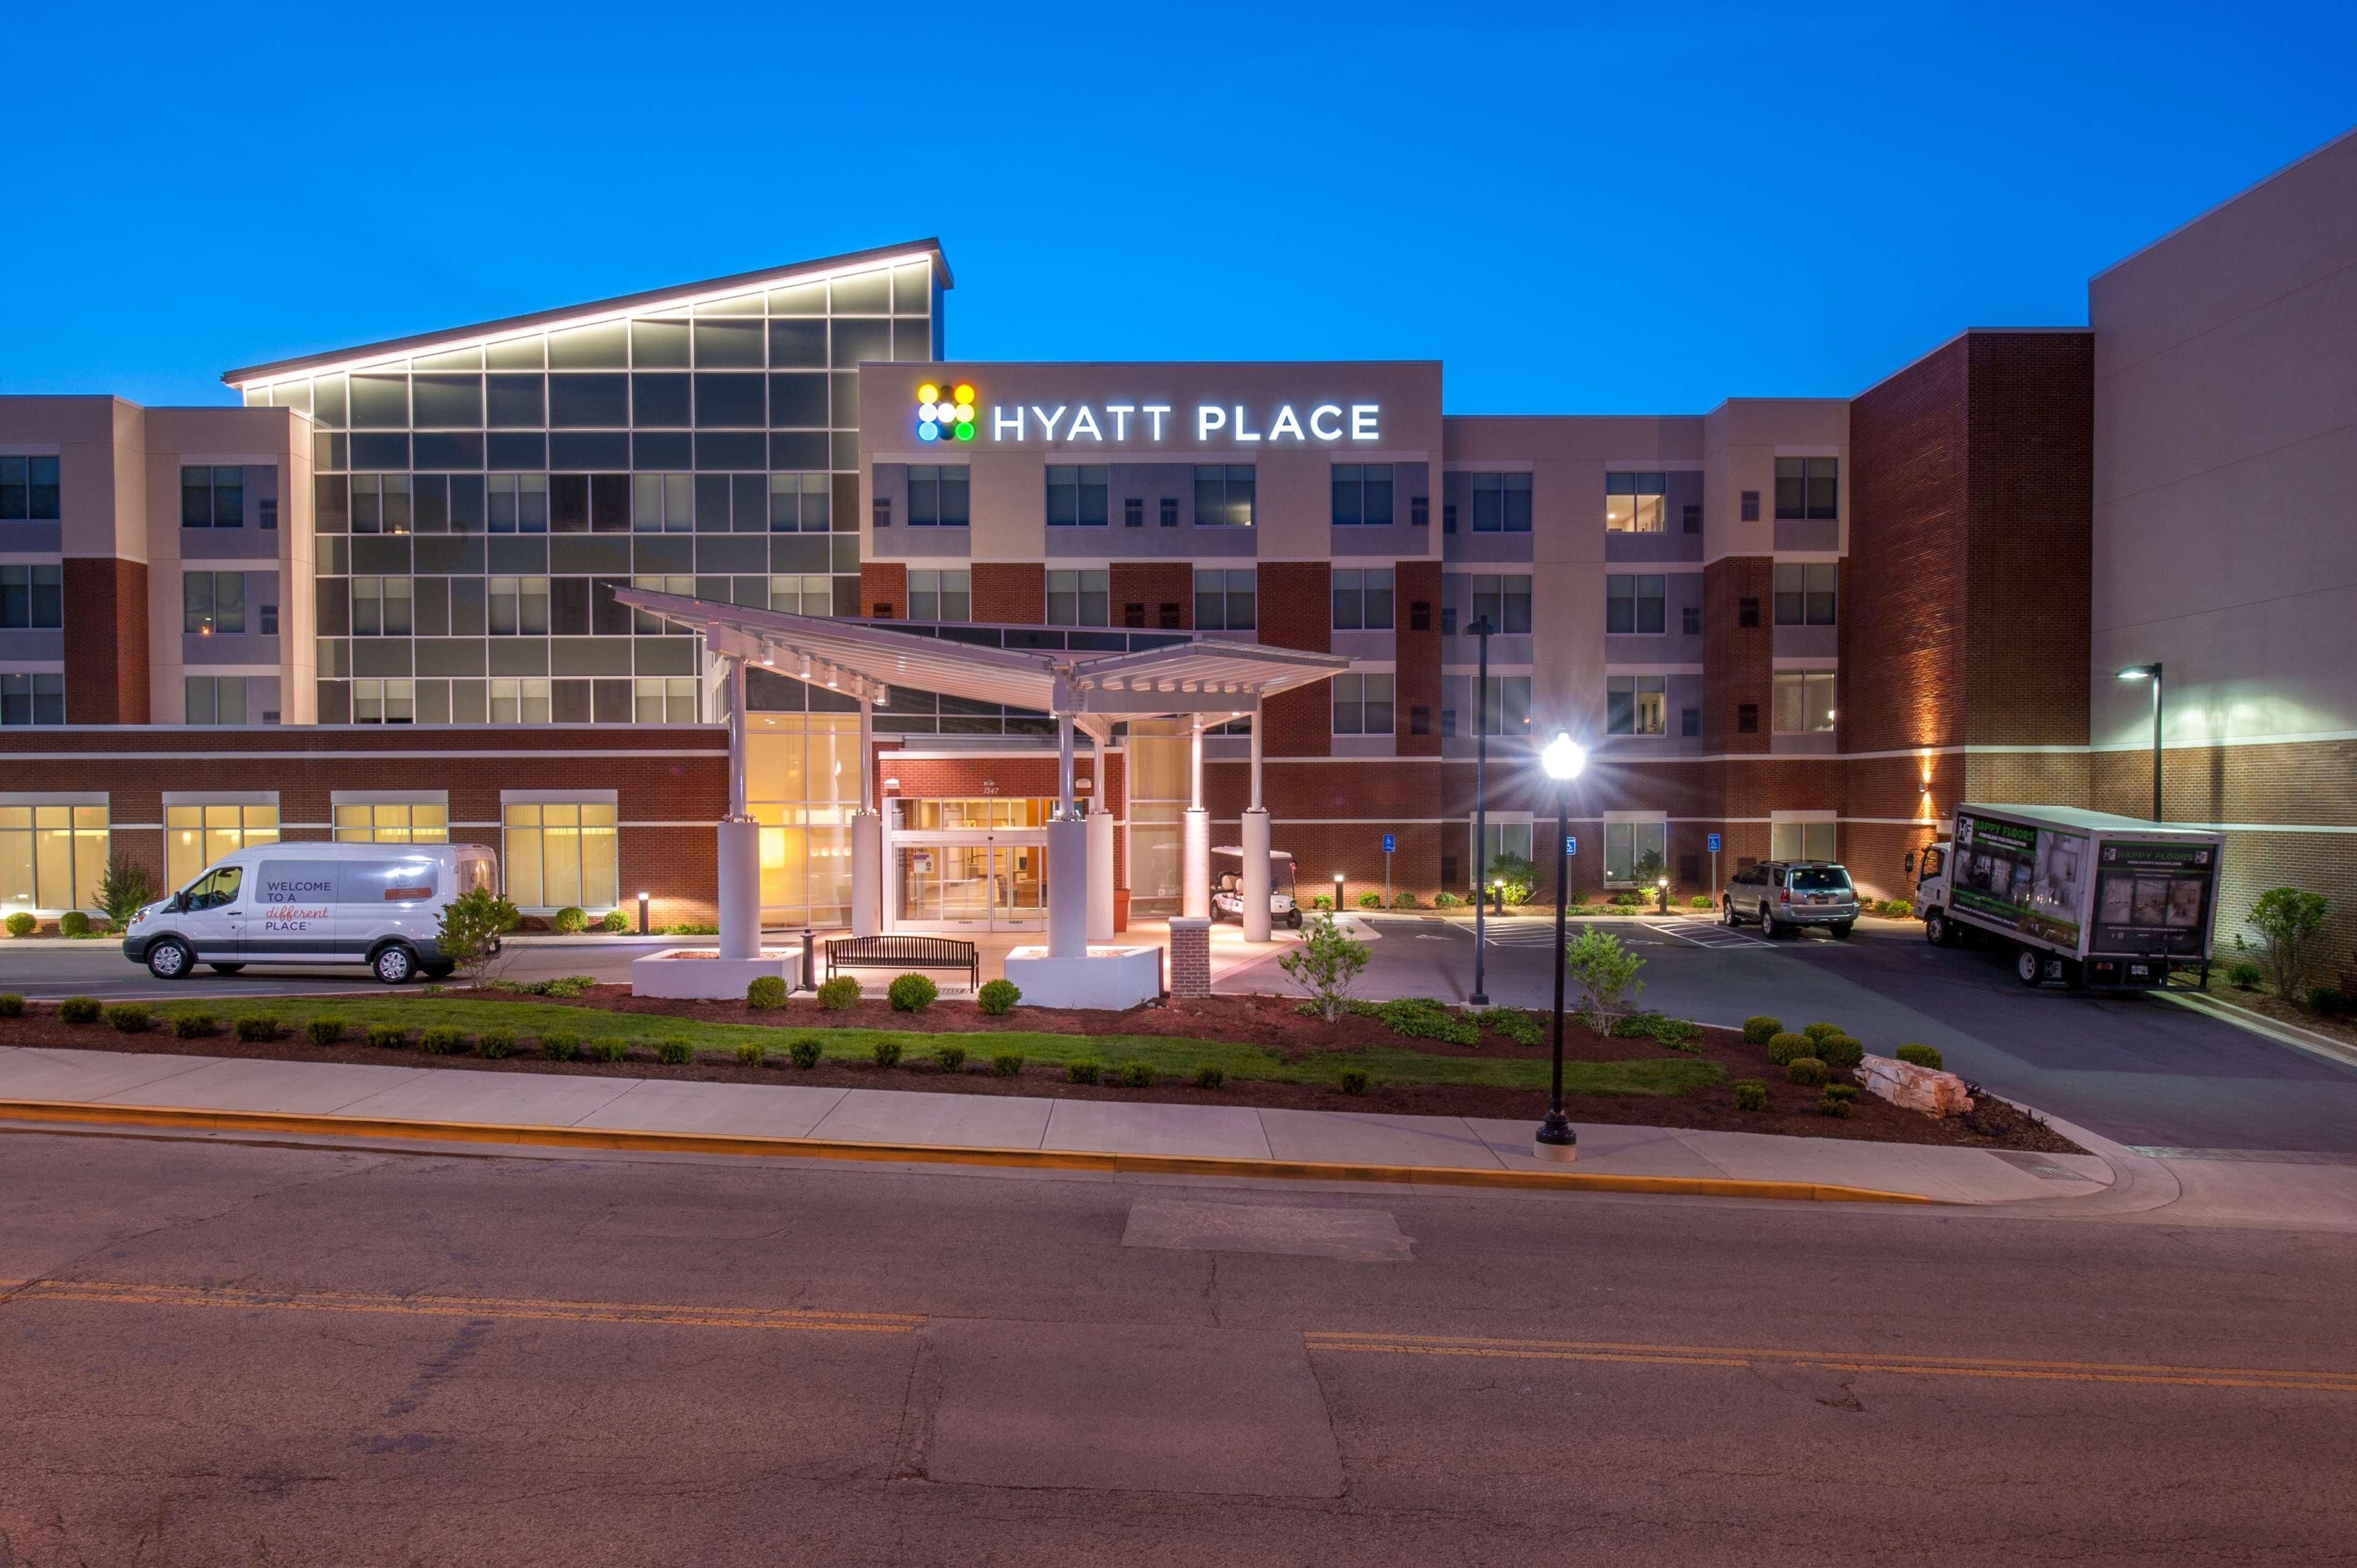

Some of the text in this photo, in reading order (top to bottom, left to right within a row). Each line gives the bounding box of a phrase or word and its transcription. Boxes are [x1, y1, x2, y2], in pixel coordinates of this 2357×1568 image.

[994, 404, 1379, 441] HYATT PLACE
[1974, 820, 2035, 841] HAPPY FLOORS
[2118, 851, 2193, 860] HAPPY FLOORS
[267, 881, 331, 891] WELCOME
[267, 893, 296, 902] TO A
[265, 905, 330, 922] different
[266, 922, 307, 931] PLACE
